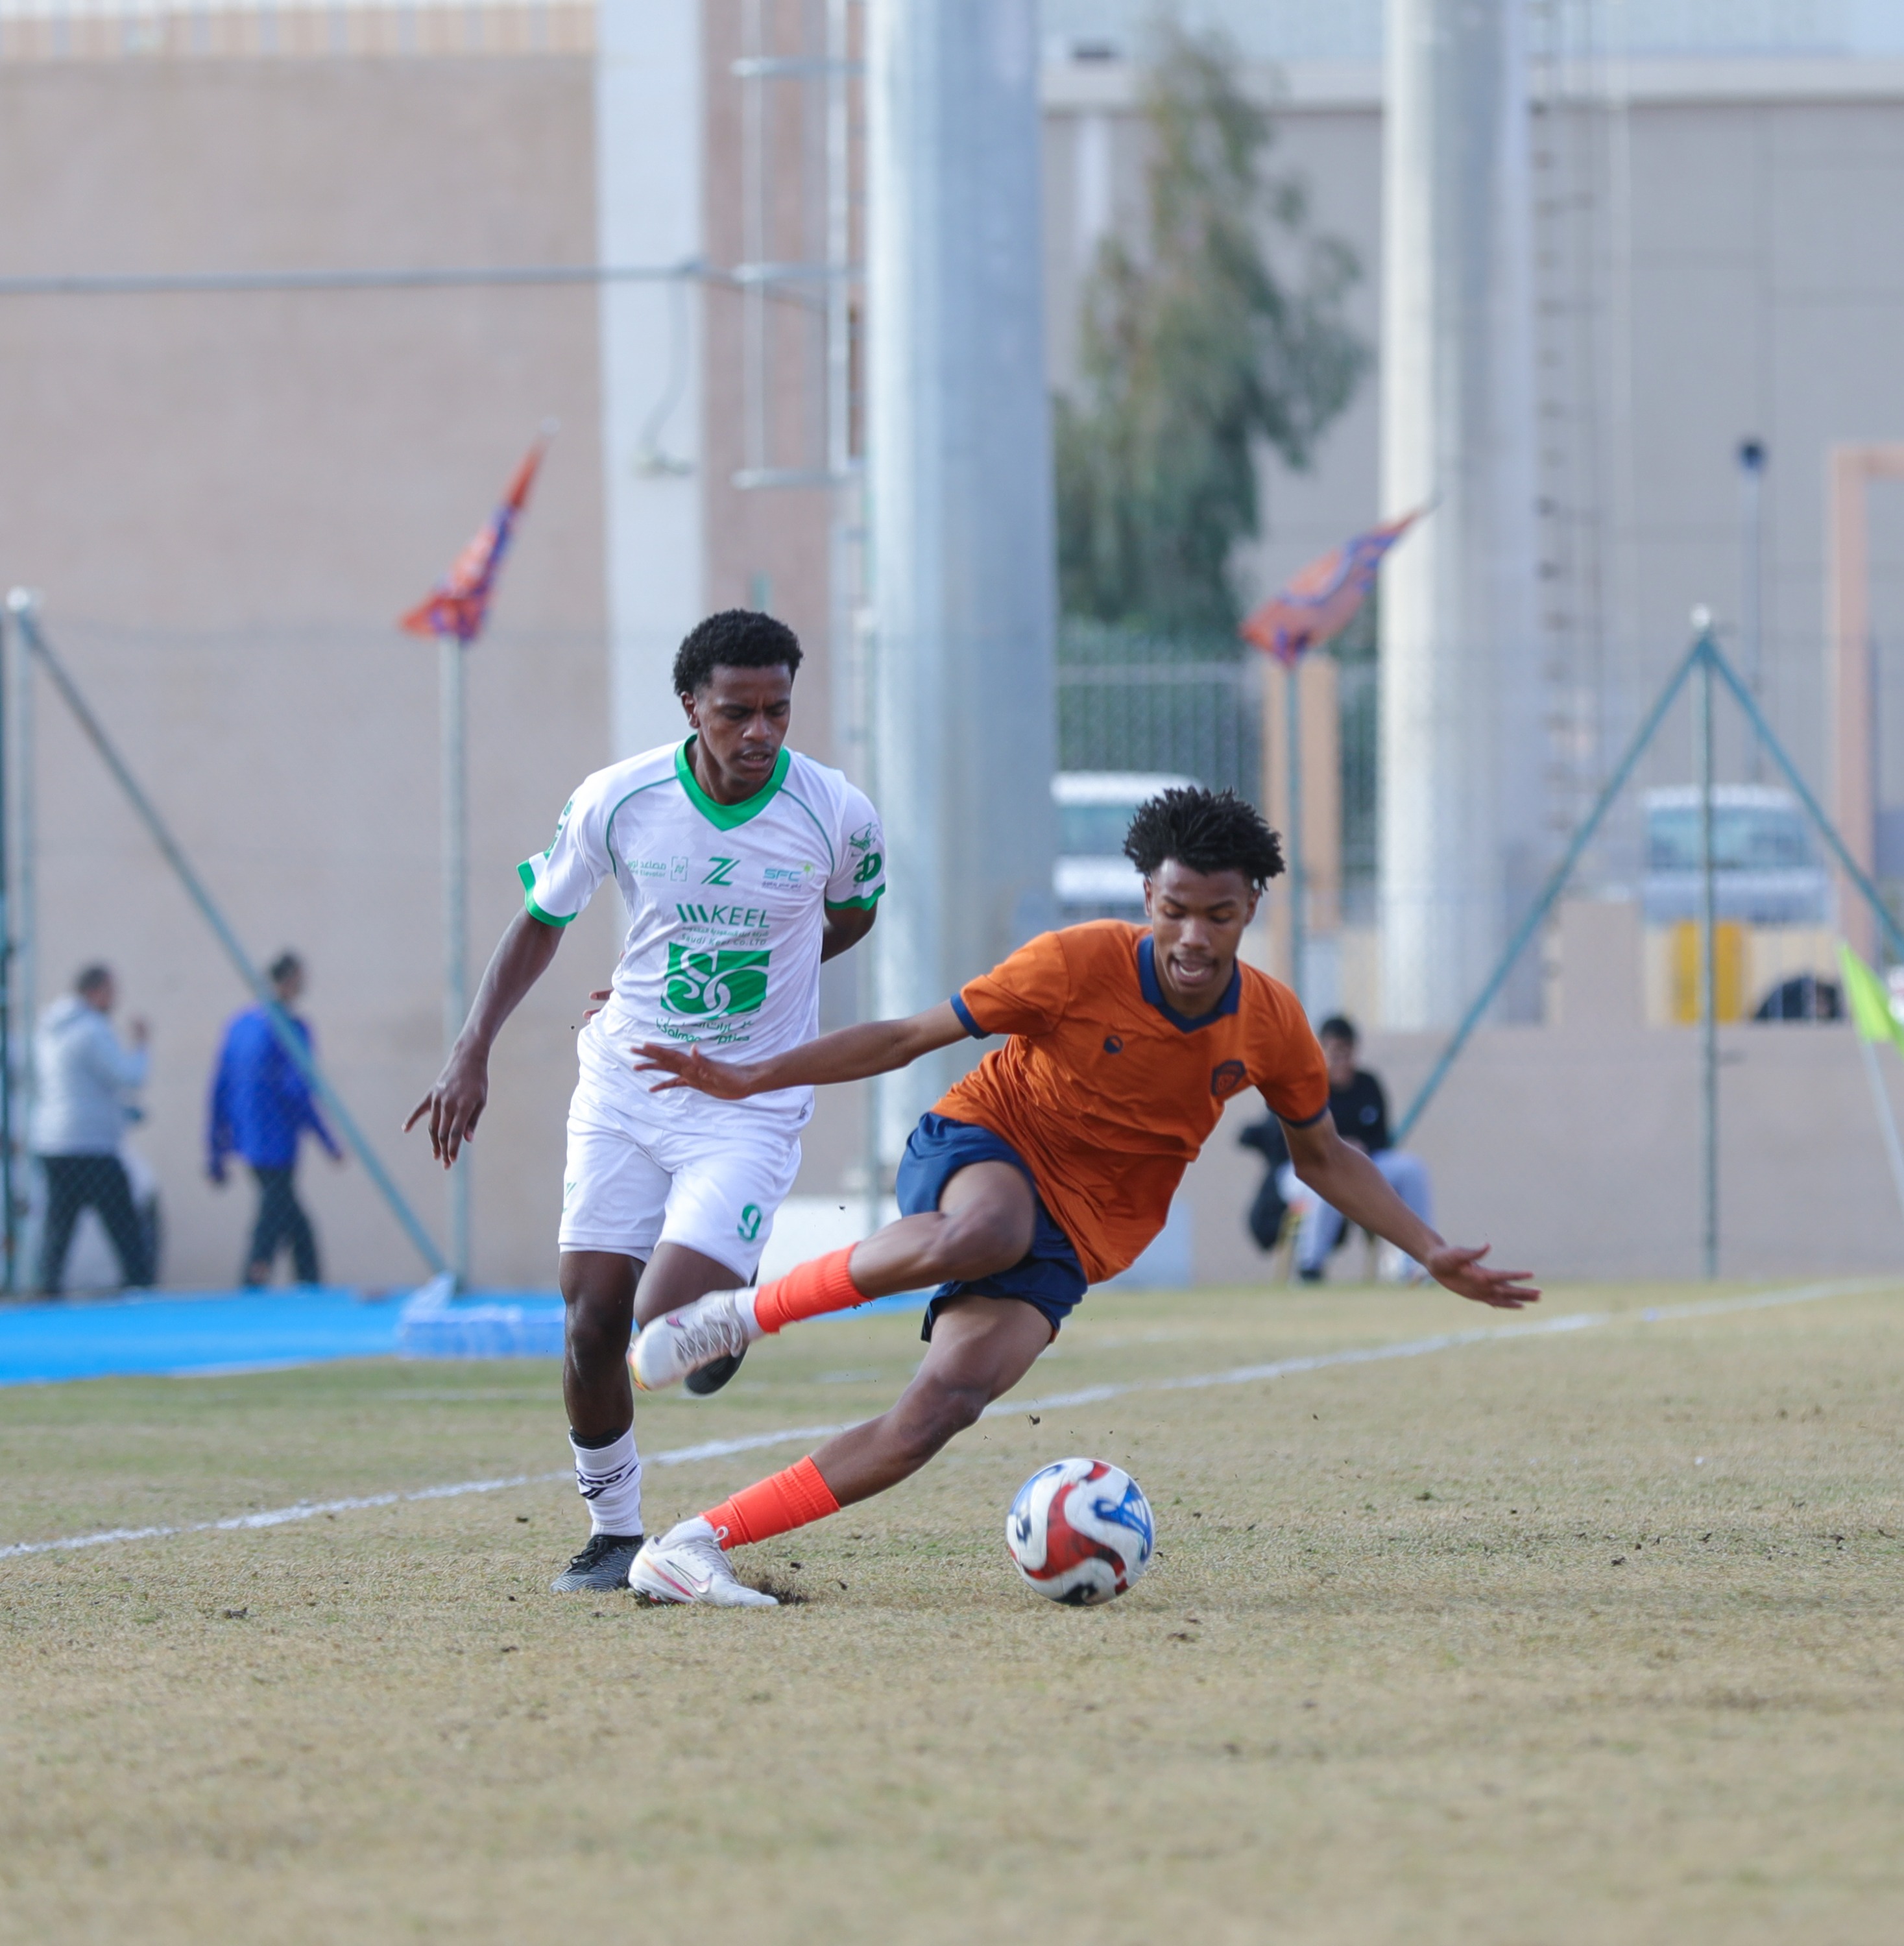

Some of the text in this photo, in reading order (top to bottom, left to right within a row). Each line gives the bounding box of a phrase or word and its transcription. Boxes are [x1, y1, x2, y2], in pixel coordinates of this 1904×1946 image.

[764, 868, 801, 882] SFC
[711, 904, 770, 928] KEEL
[682, 933, 706, 945] Saudi
[737, 1203, 762, 1242] 9
